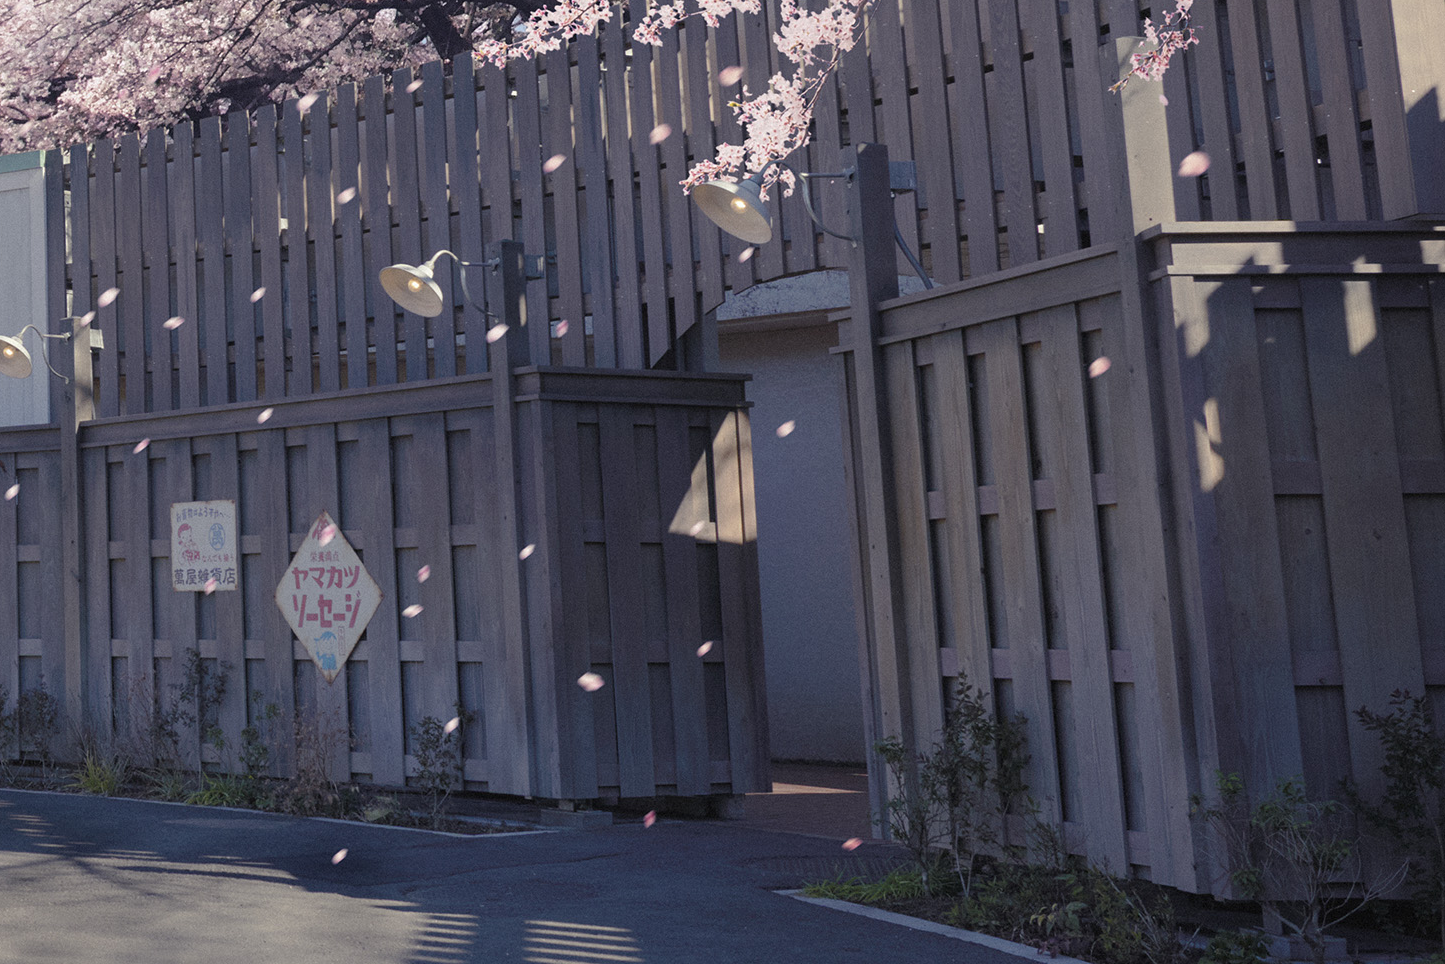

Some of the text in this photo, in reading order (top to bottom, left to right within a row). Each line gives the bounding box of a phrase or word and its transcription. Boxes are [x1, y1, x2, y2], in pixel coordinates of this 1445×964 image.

[292, 565, 360, 589] ヤマカツ
[293, 591, 361, 628] ソーセージ
